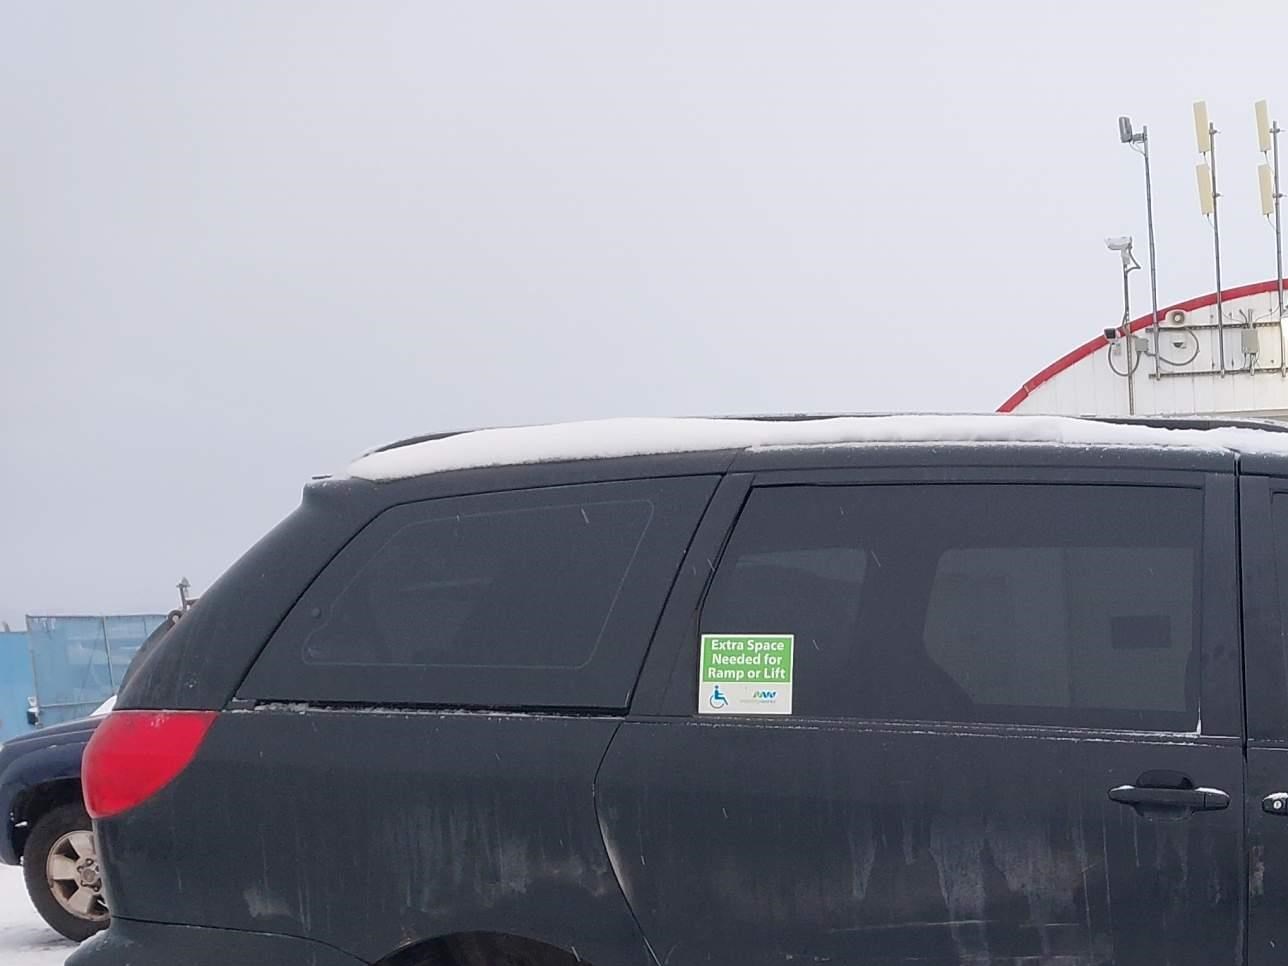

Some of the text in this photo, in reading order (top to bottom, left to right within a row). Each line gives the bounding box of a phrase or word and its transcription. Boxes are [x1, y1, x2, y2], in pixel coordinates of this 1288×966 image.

[711, 639, 785, 653] Extra Space
[712, 653, 783, 665] Needed for
[708, 667, 786, 681] Ramp or Lift
